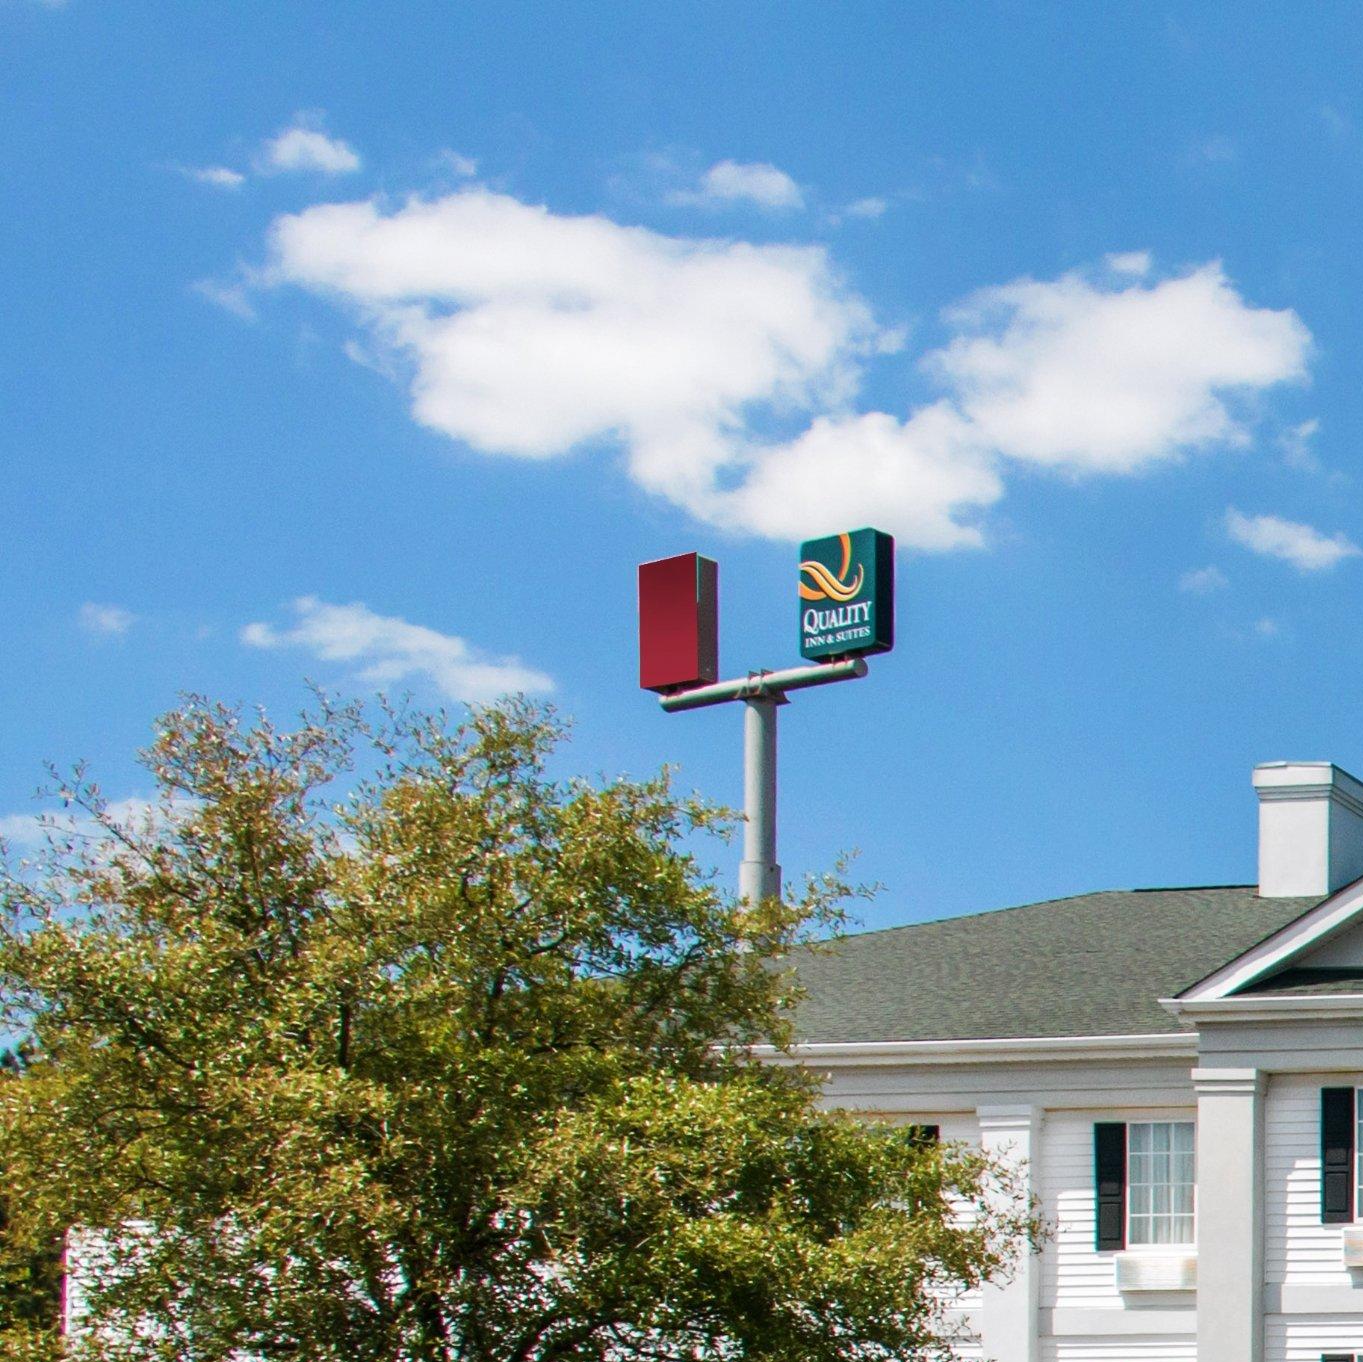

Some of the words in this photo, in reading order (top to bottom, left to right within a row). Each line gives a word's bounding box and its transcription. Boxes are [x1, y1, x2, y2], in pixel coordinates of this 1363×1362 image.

[804, 601, 872, 634] QUALITY
[805, 635, 825, 648] INN
[826, 634, 834, 644] &
[836, 626, 871, 642] SUITES
